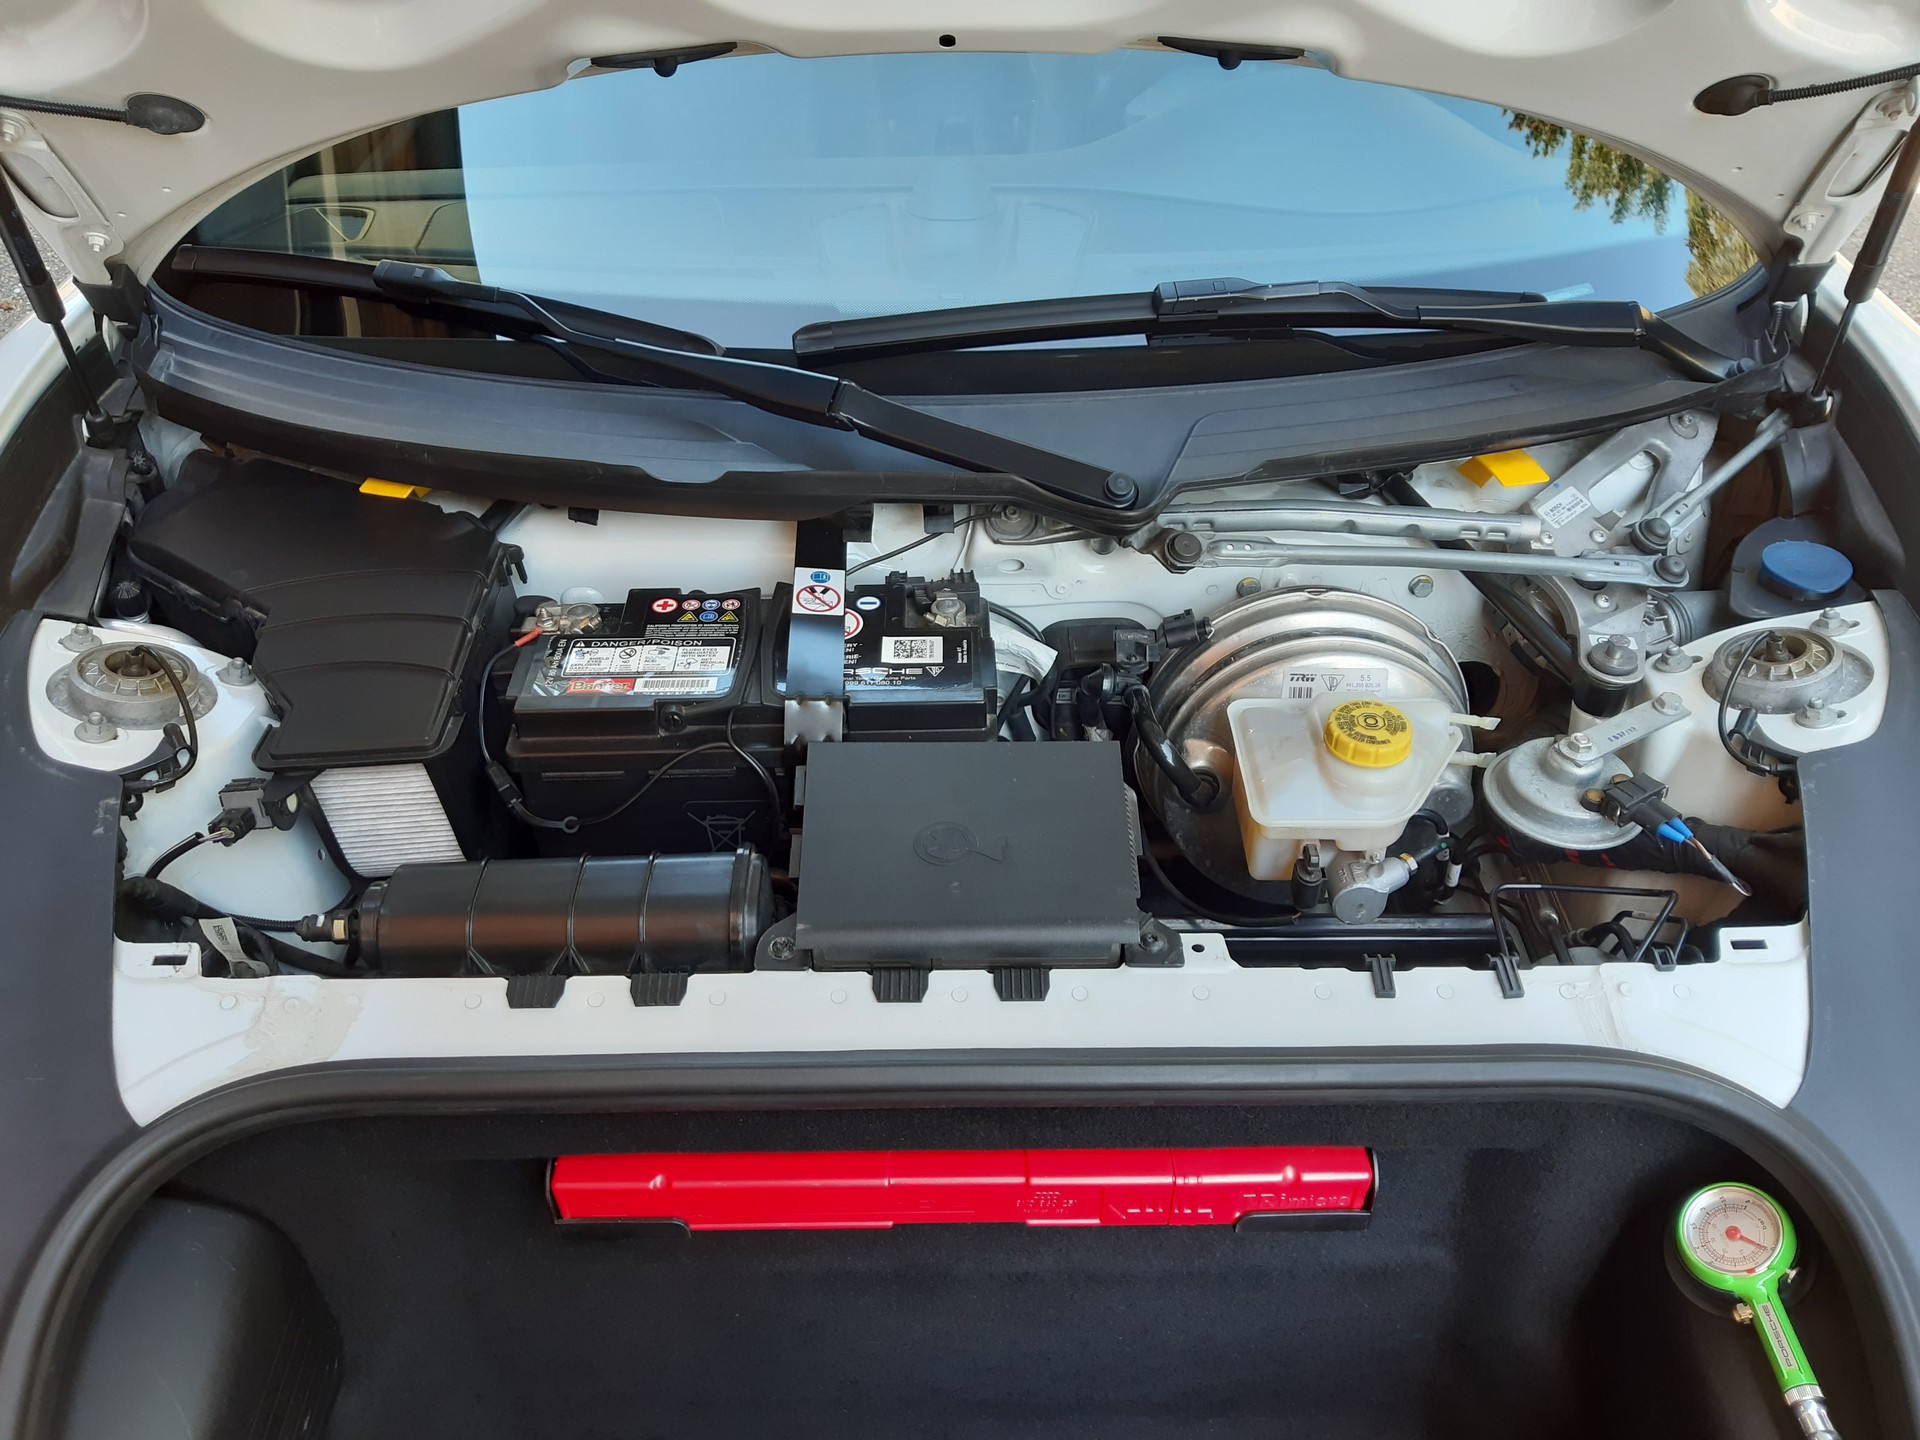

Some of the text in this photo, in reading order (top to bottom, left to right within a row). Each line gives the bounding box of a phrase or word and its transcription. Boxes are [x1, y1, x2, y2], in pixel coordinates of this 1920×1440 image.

[1290, 673, 1317, 682] TRW
[573, 682, 631, 690] Banner
[1762, 1304, 1793, 1368] PORSCHE
